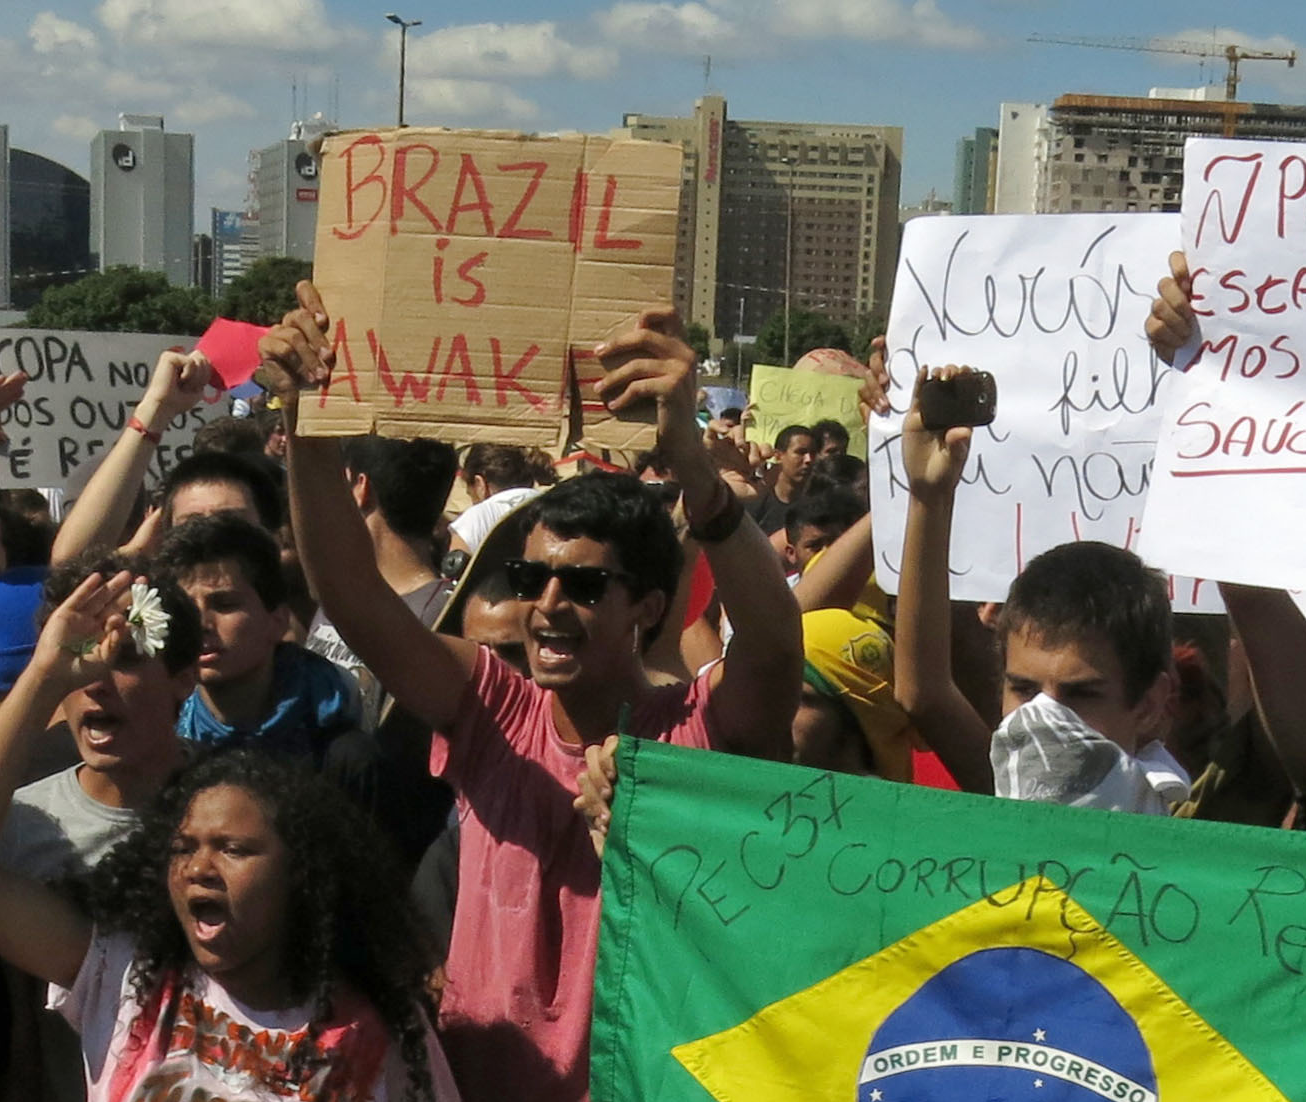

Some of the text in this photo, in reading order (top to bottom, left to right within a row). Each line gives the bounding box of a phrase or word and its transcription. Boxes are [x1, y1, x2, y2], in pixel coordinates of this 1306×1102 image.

[333, 134, 644, 253] BRAZIL
[10, 437, 33, 479] É
[826, 842, 1201, 960] CORRUPÇÃO
[872, 1042, 960, 1074] ORDEM
[971, 1044, 986, 1060] E
